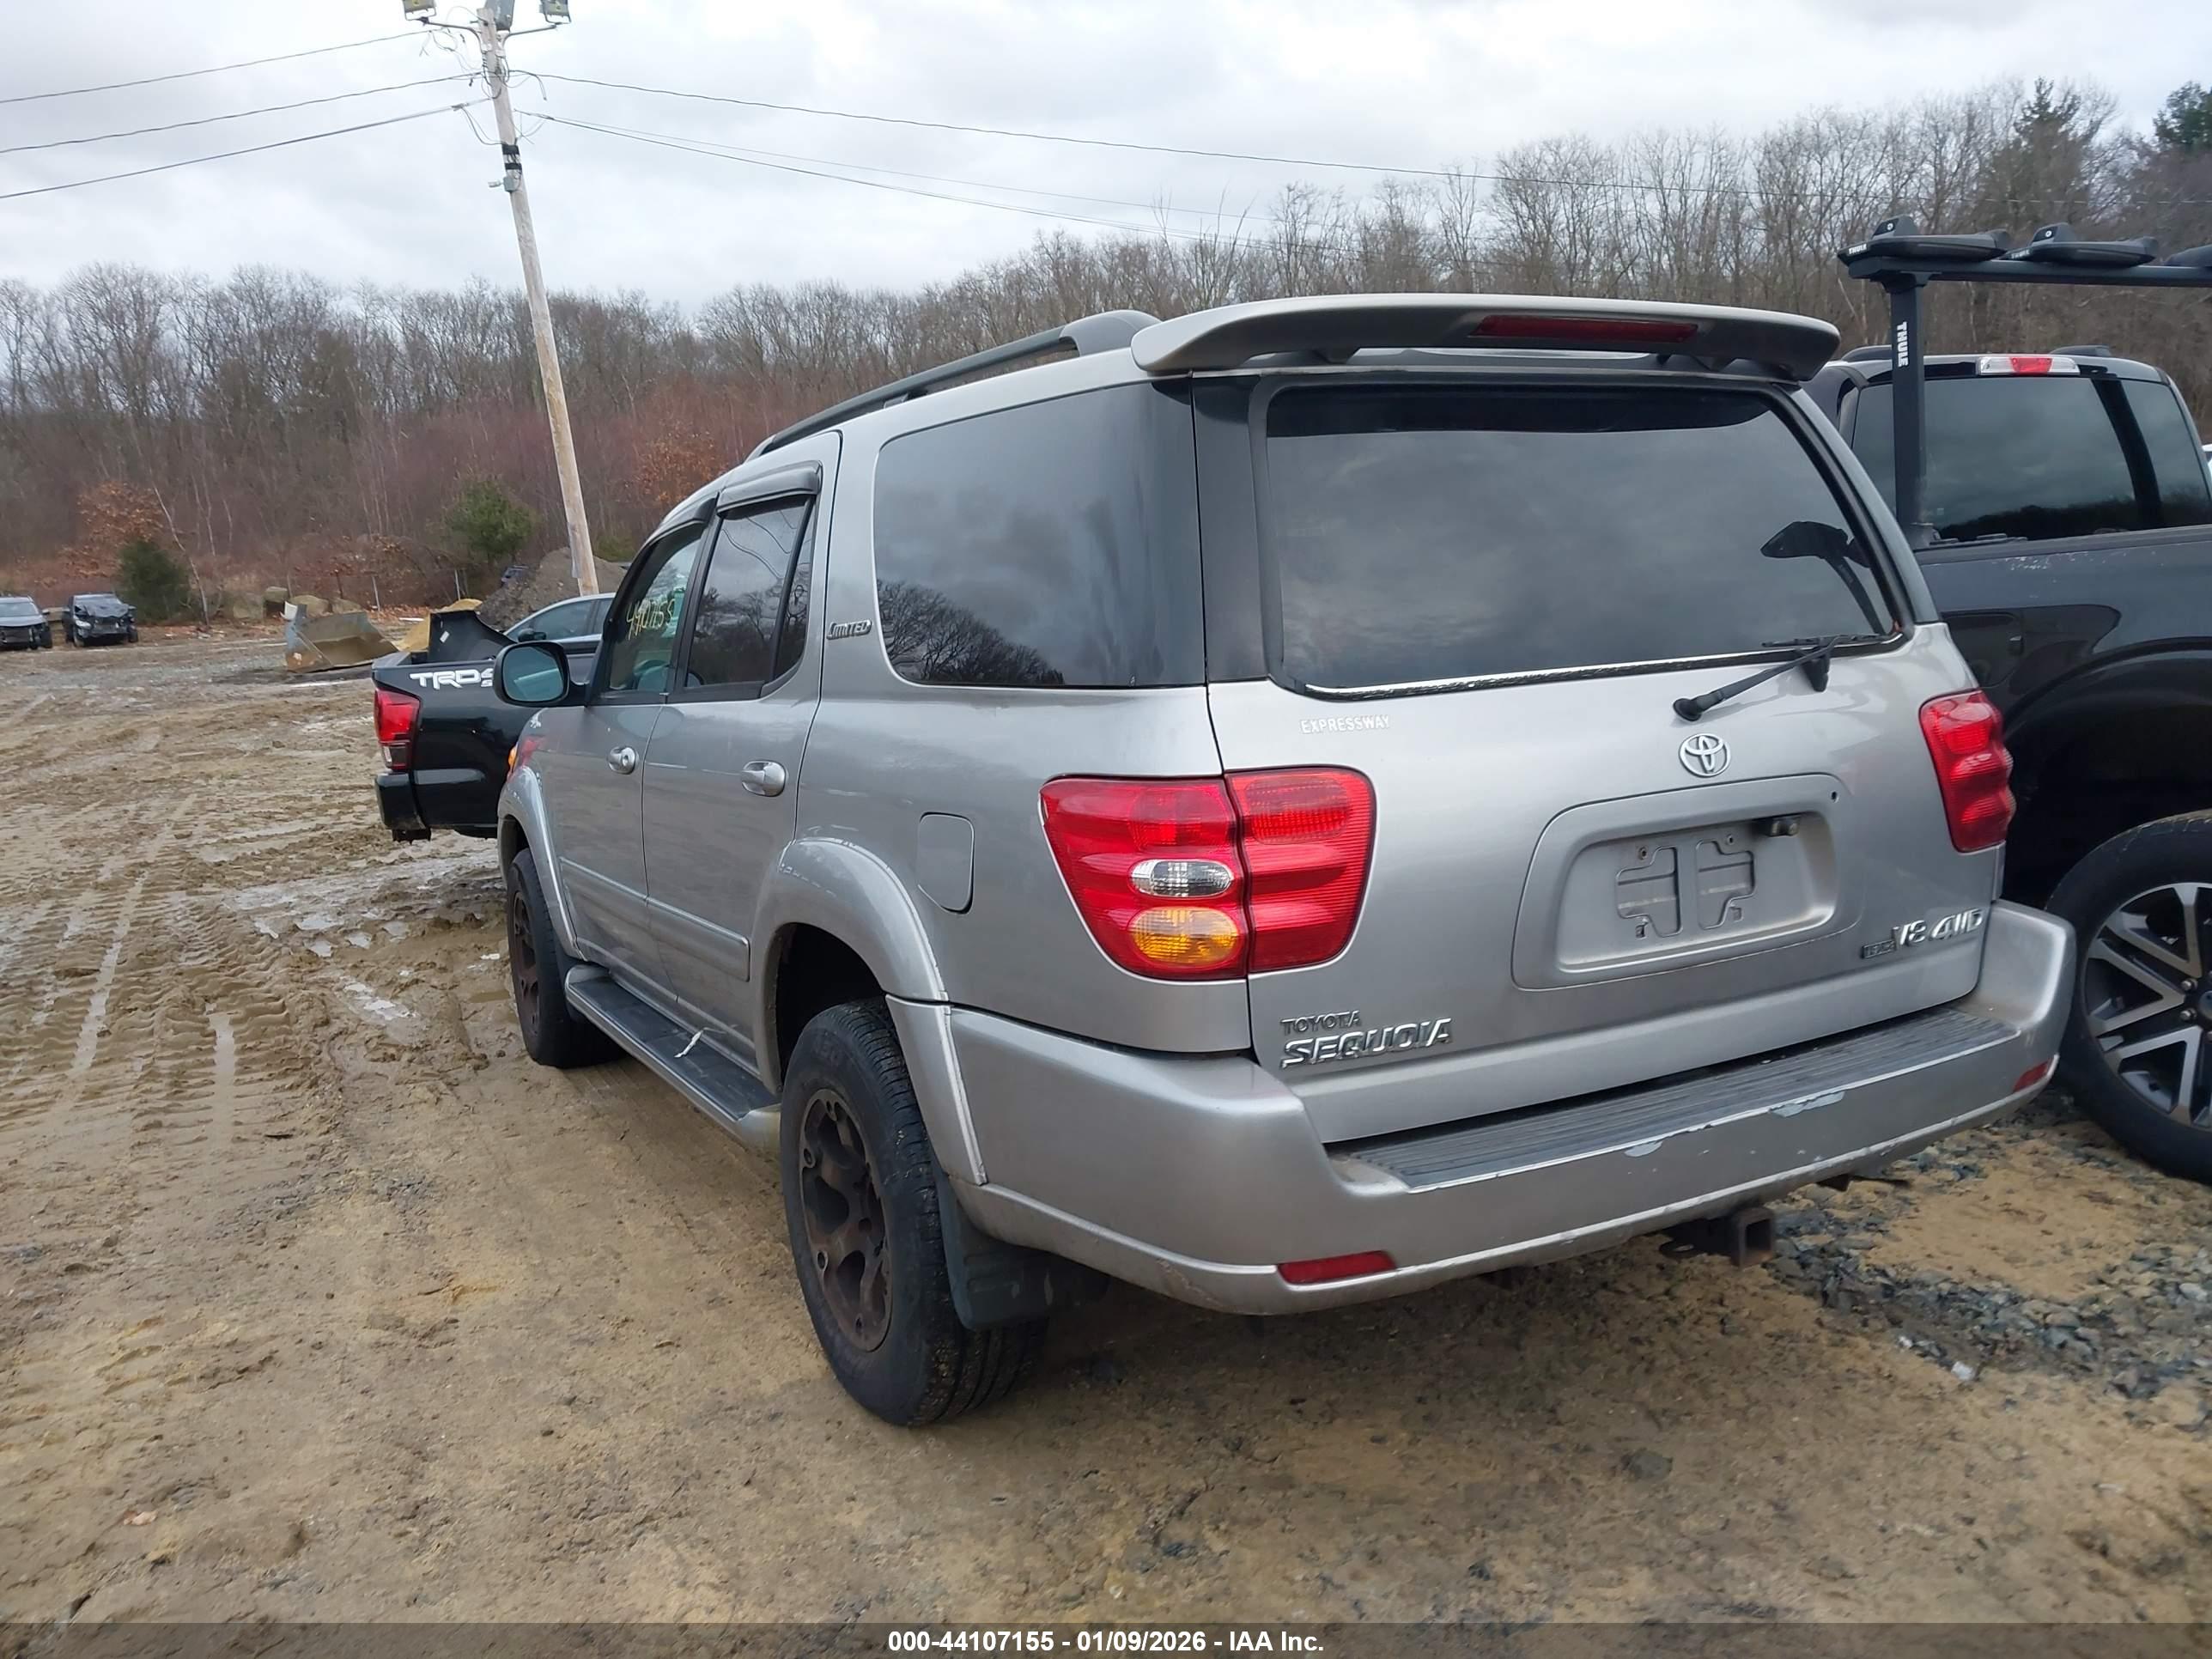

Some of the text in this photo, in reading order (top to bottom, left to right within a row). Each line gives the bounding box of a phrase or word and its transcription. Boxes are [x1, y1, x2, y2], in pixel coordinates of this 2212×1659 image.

[1897, 321, 1908, 367] THULE
[410, 669, 481, 690] TRD
[1300, 714, 1389, 733] EXPRESSWAY
[1892, 908, 1984, 946] V8 4WD
[1280, 1010, 1361, 1034] TOYOTA
[1279, 1018, 1453, 1068] SEQUOIA
